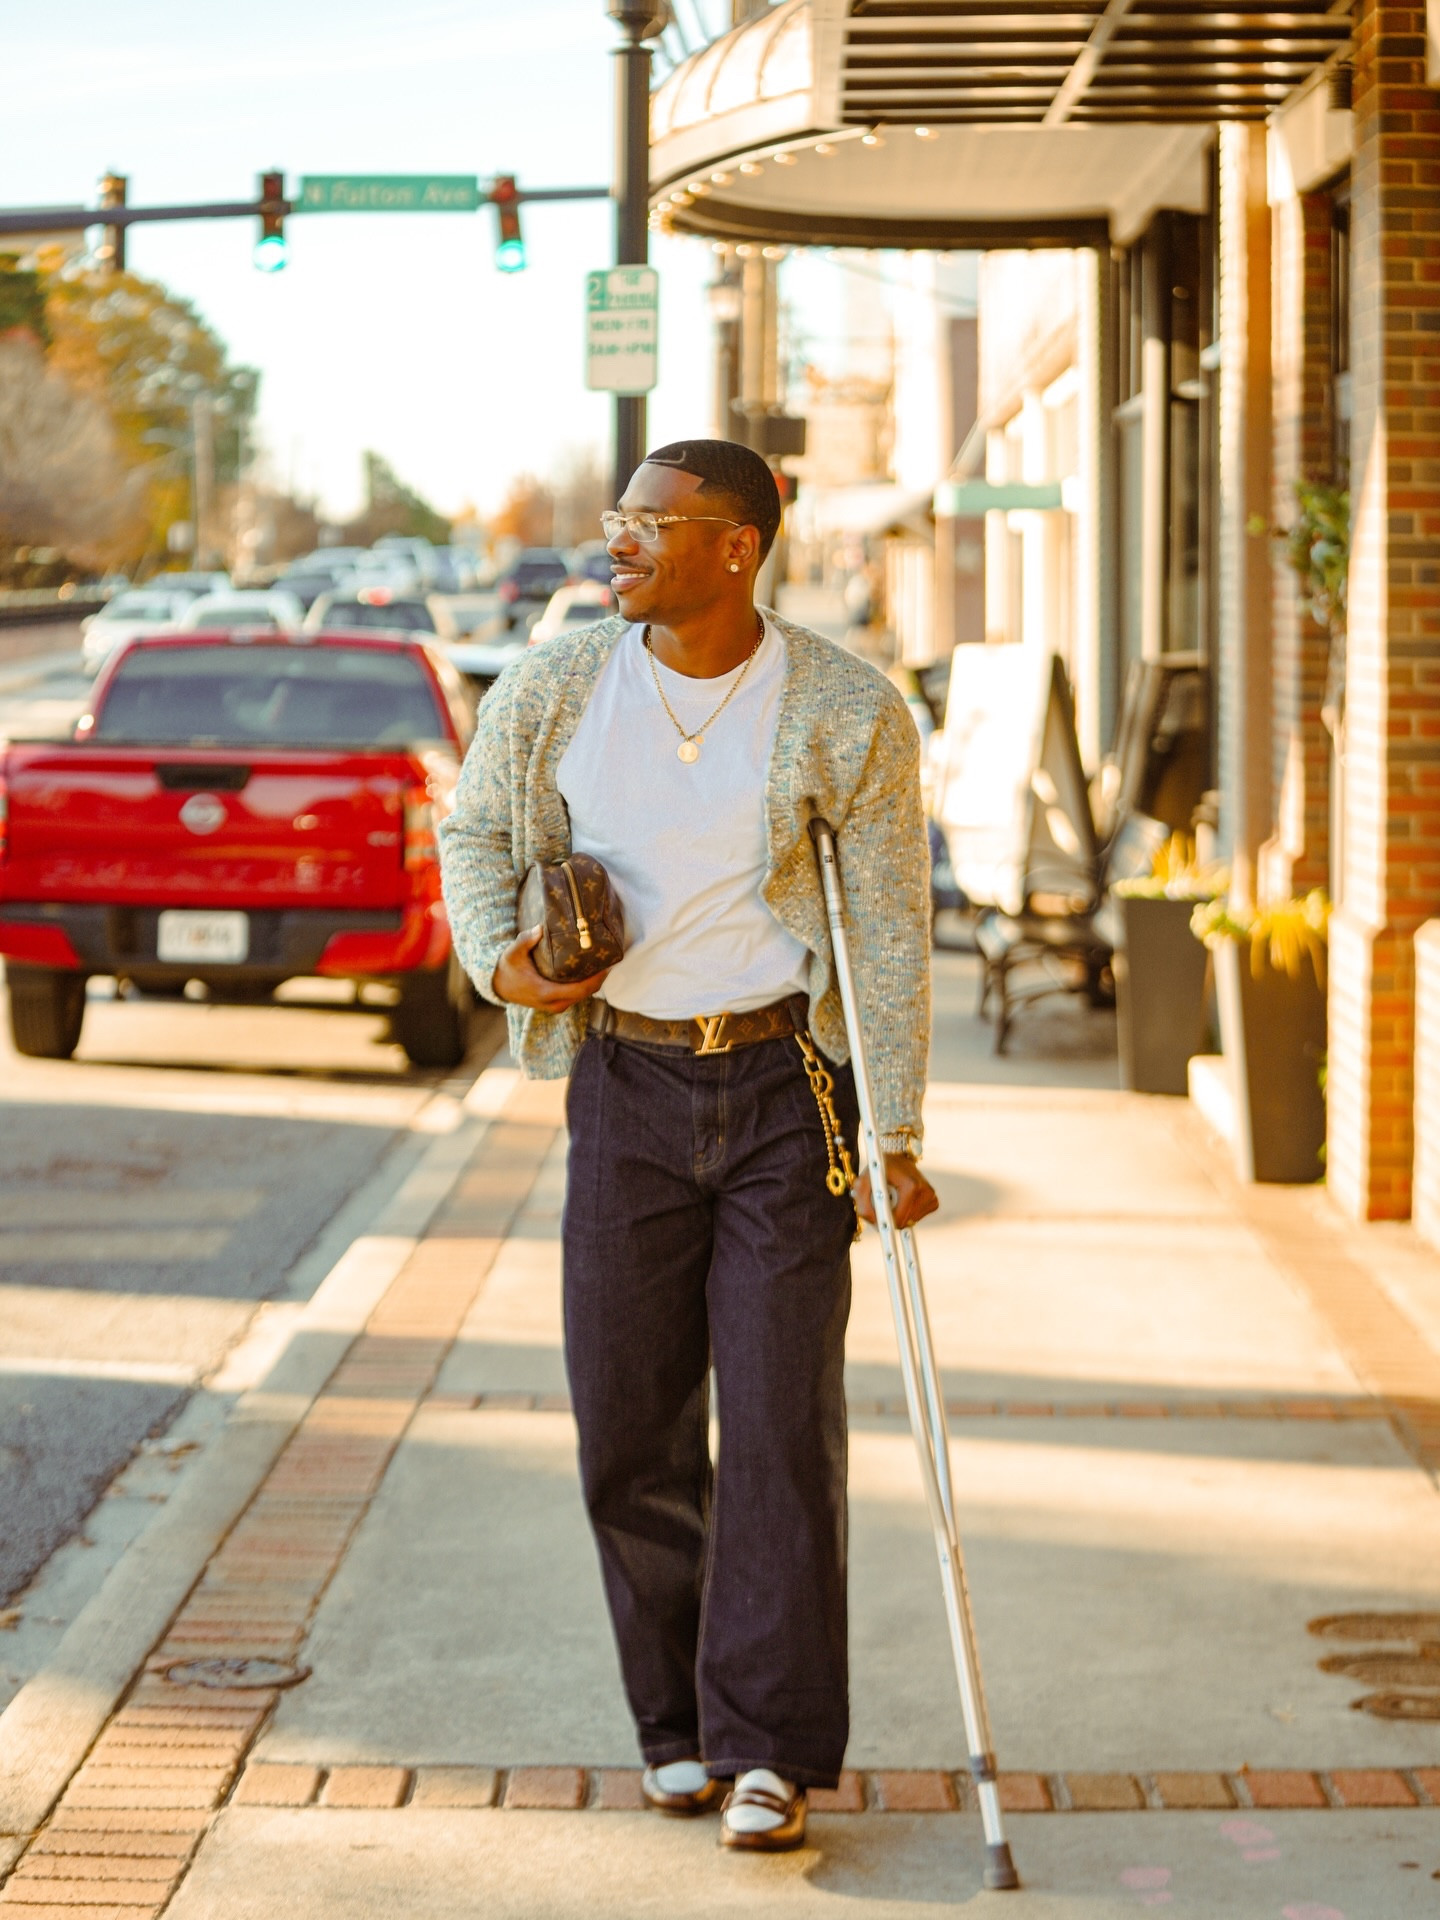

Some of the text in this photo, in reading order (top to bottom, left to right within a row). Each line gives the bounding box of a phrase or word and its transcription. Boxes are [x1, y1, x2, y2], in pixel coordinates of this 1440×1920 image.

[303, 180, 470, 207] N Fulton Ave
[588, 276, 601, 306] 2
